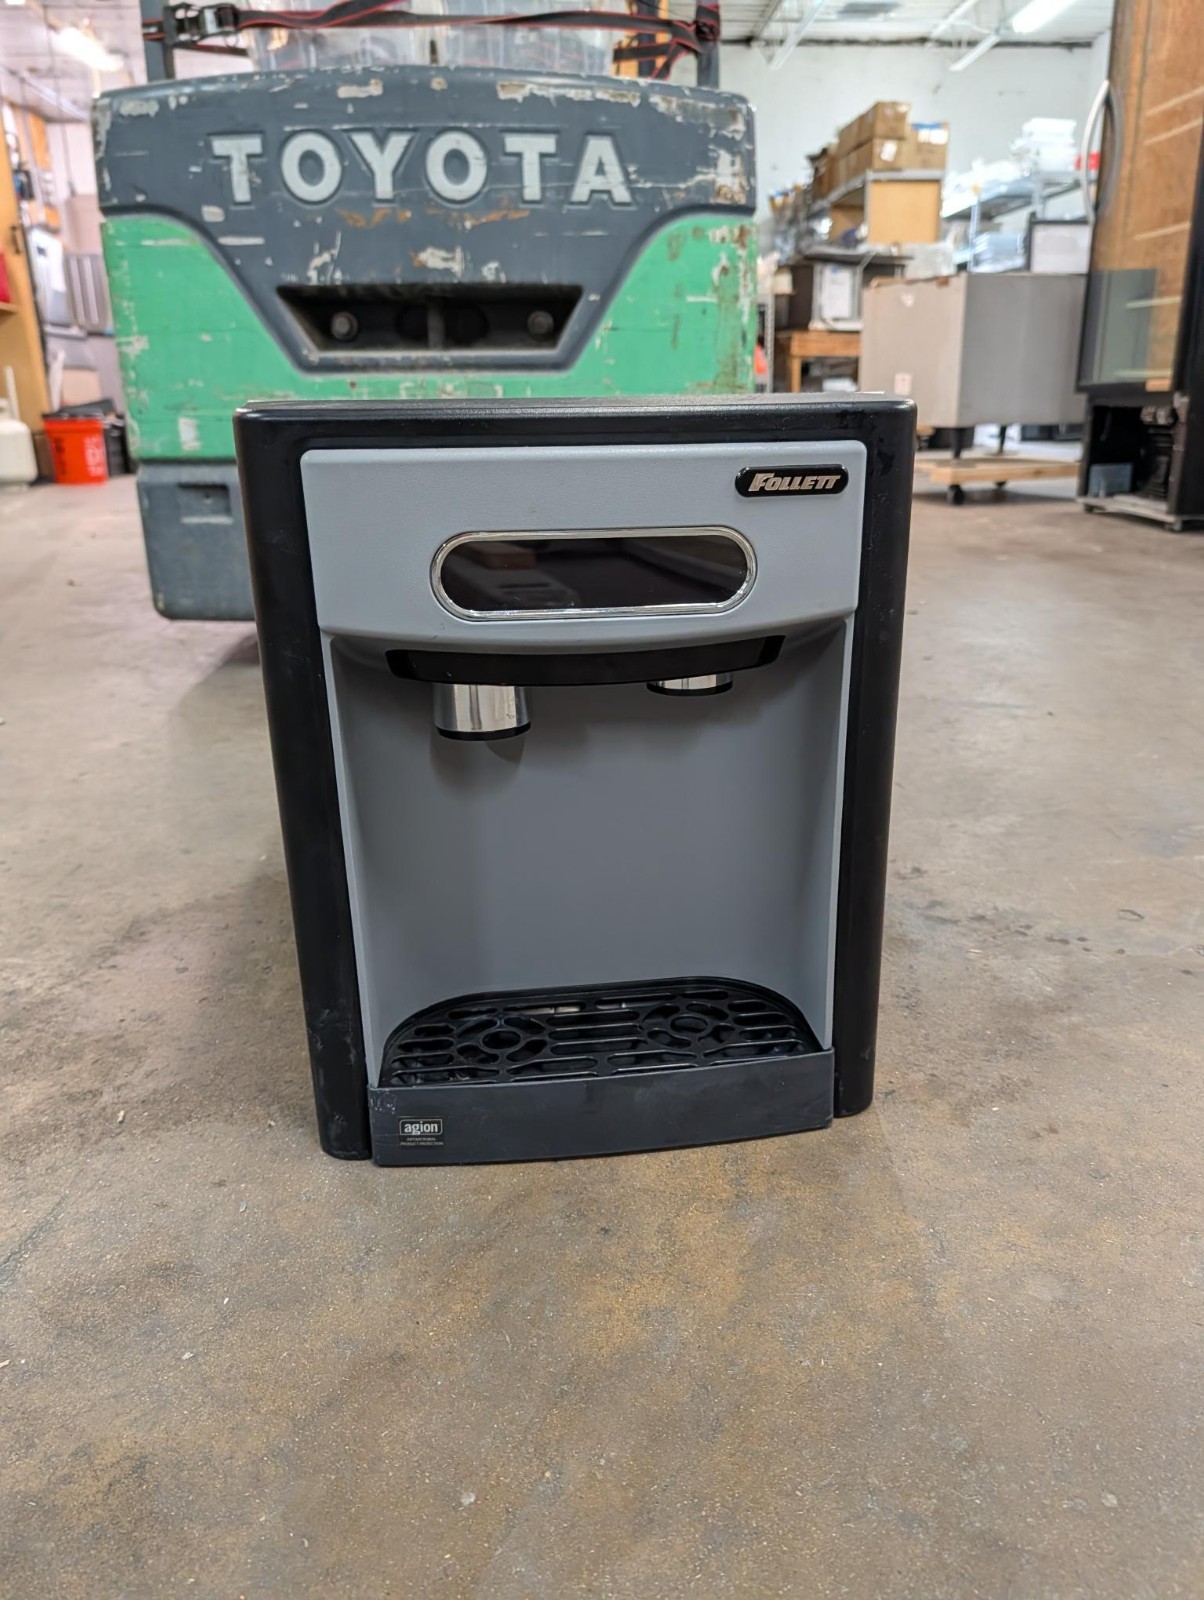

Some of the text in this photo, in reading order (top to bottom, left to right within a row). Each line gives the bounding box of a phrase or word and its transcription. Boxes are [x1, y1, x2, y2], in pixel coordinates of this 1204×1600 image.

[211, 131, 632, 203] TOYOTA
[748, 473, 841, 492] FOLLETT
[404, 1121, 438, 1135] agion
